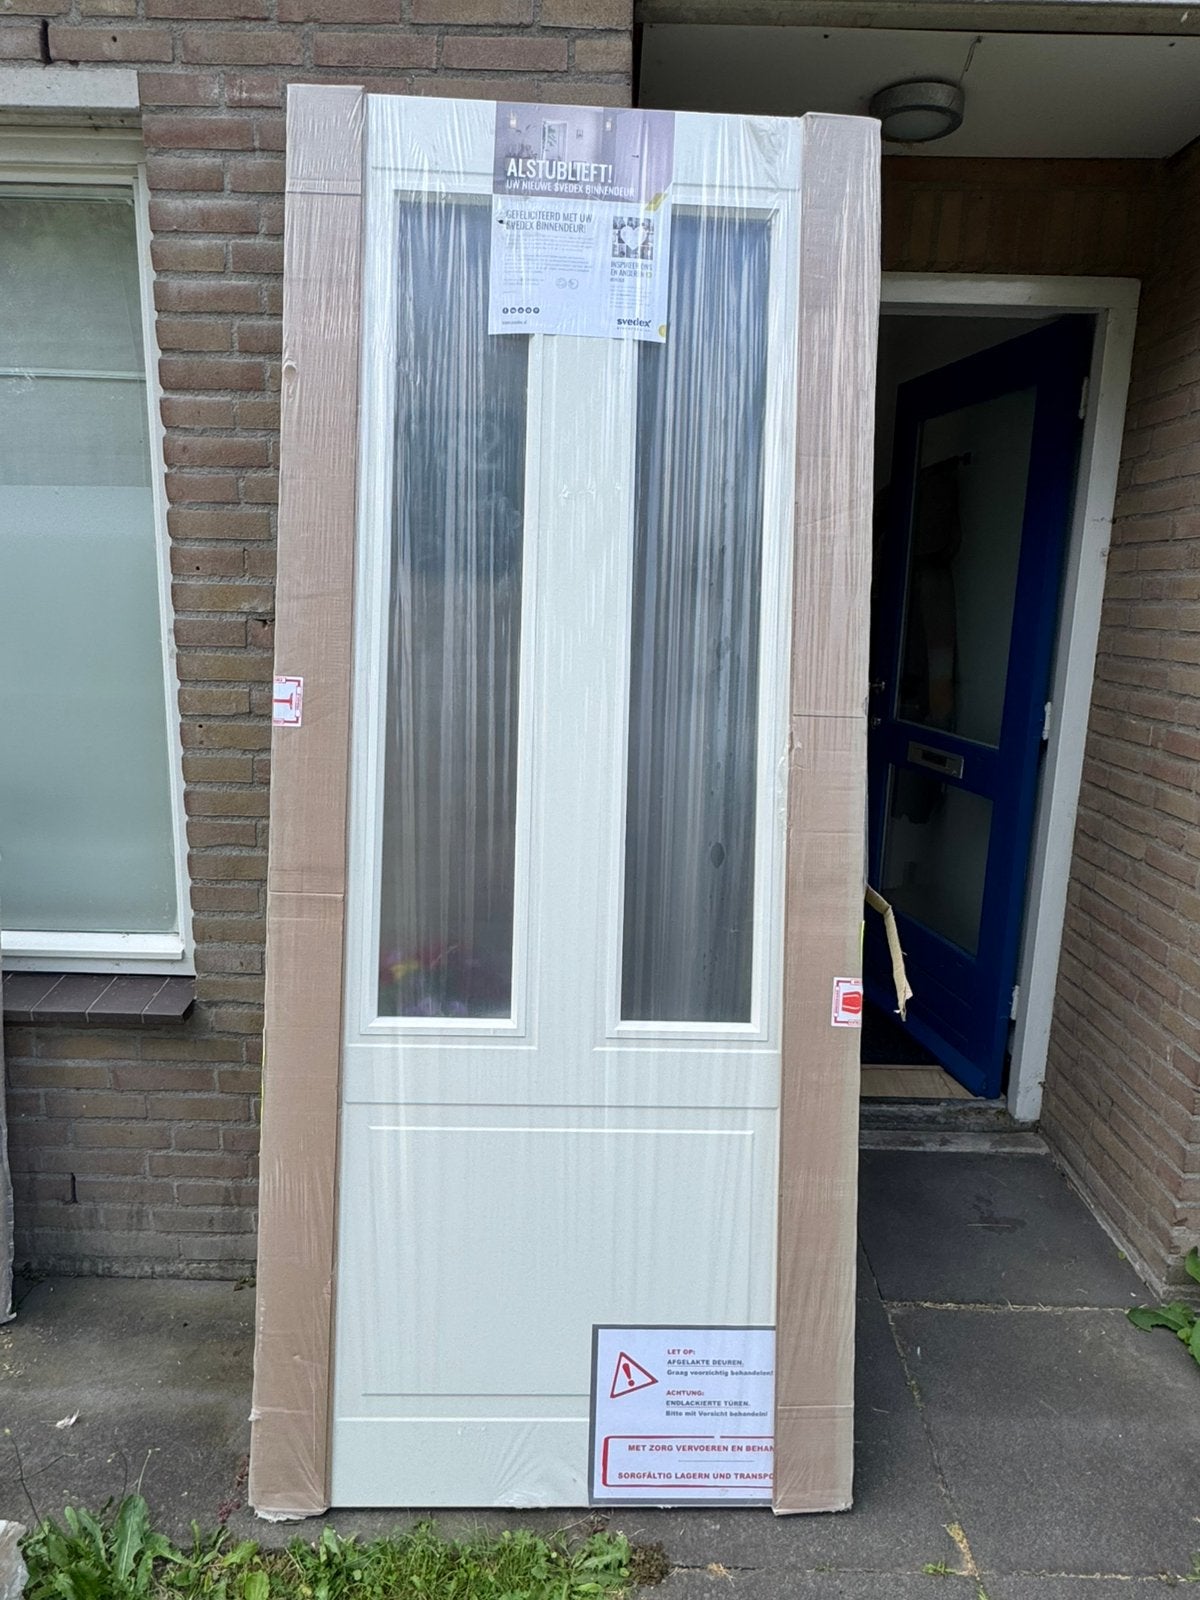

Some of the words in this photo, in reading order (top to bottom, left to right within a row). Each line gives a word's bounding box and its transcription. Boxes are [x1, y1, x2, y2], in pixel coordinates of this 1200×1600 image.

[506, 157, 613, 184] ALSTUBLIEFT!
[506, 180, 520, 190] UW
[522, 181, 552, 192] NIEUWE
[554, 182, 584, 194] SVEDEX
[506, 210, 560, 221] GEFELICITEERD
[562, 212, 578, 223] MET
[579, 213, 593, 223] UW
[506, 220, 534, 231] SVEDEX
[617, 318, 651, 328] svedex
[667, 1369, 688, 1377] Graag
[690, 1370, 729, 1378] voorzichtig
[729, 1410, 768, 1418] behandeln!
[628, 1444, 647, 1452] MET
[649, 1444, 673, 1452] ZORG
[675, 1444, 729, 1453] VERVOEREN
[617, 1471, 673, 1480] SORGFÄLTIG
[674, 1472, 710, 1480] LAGERN
